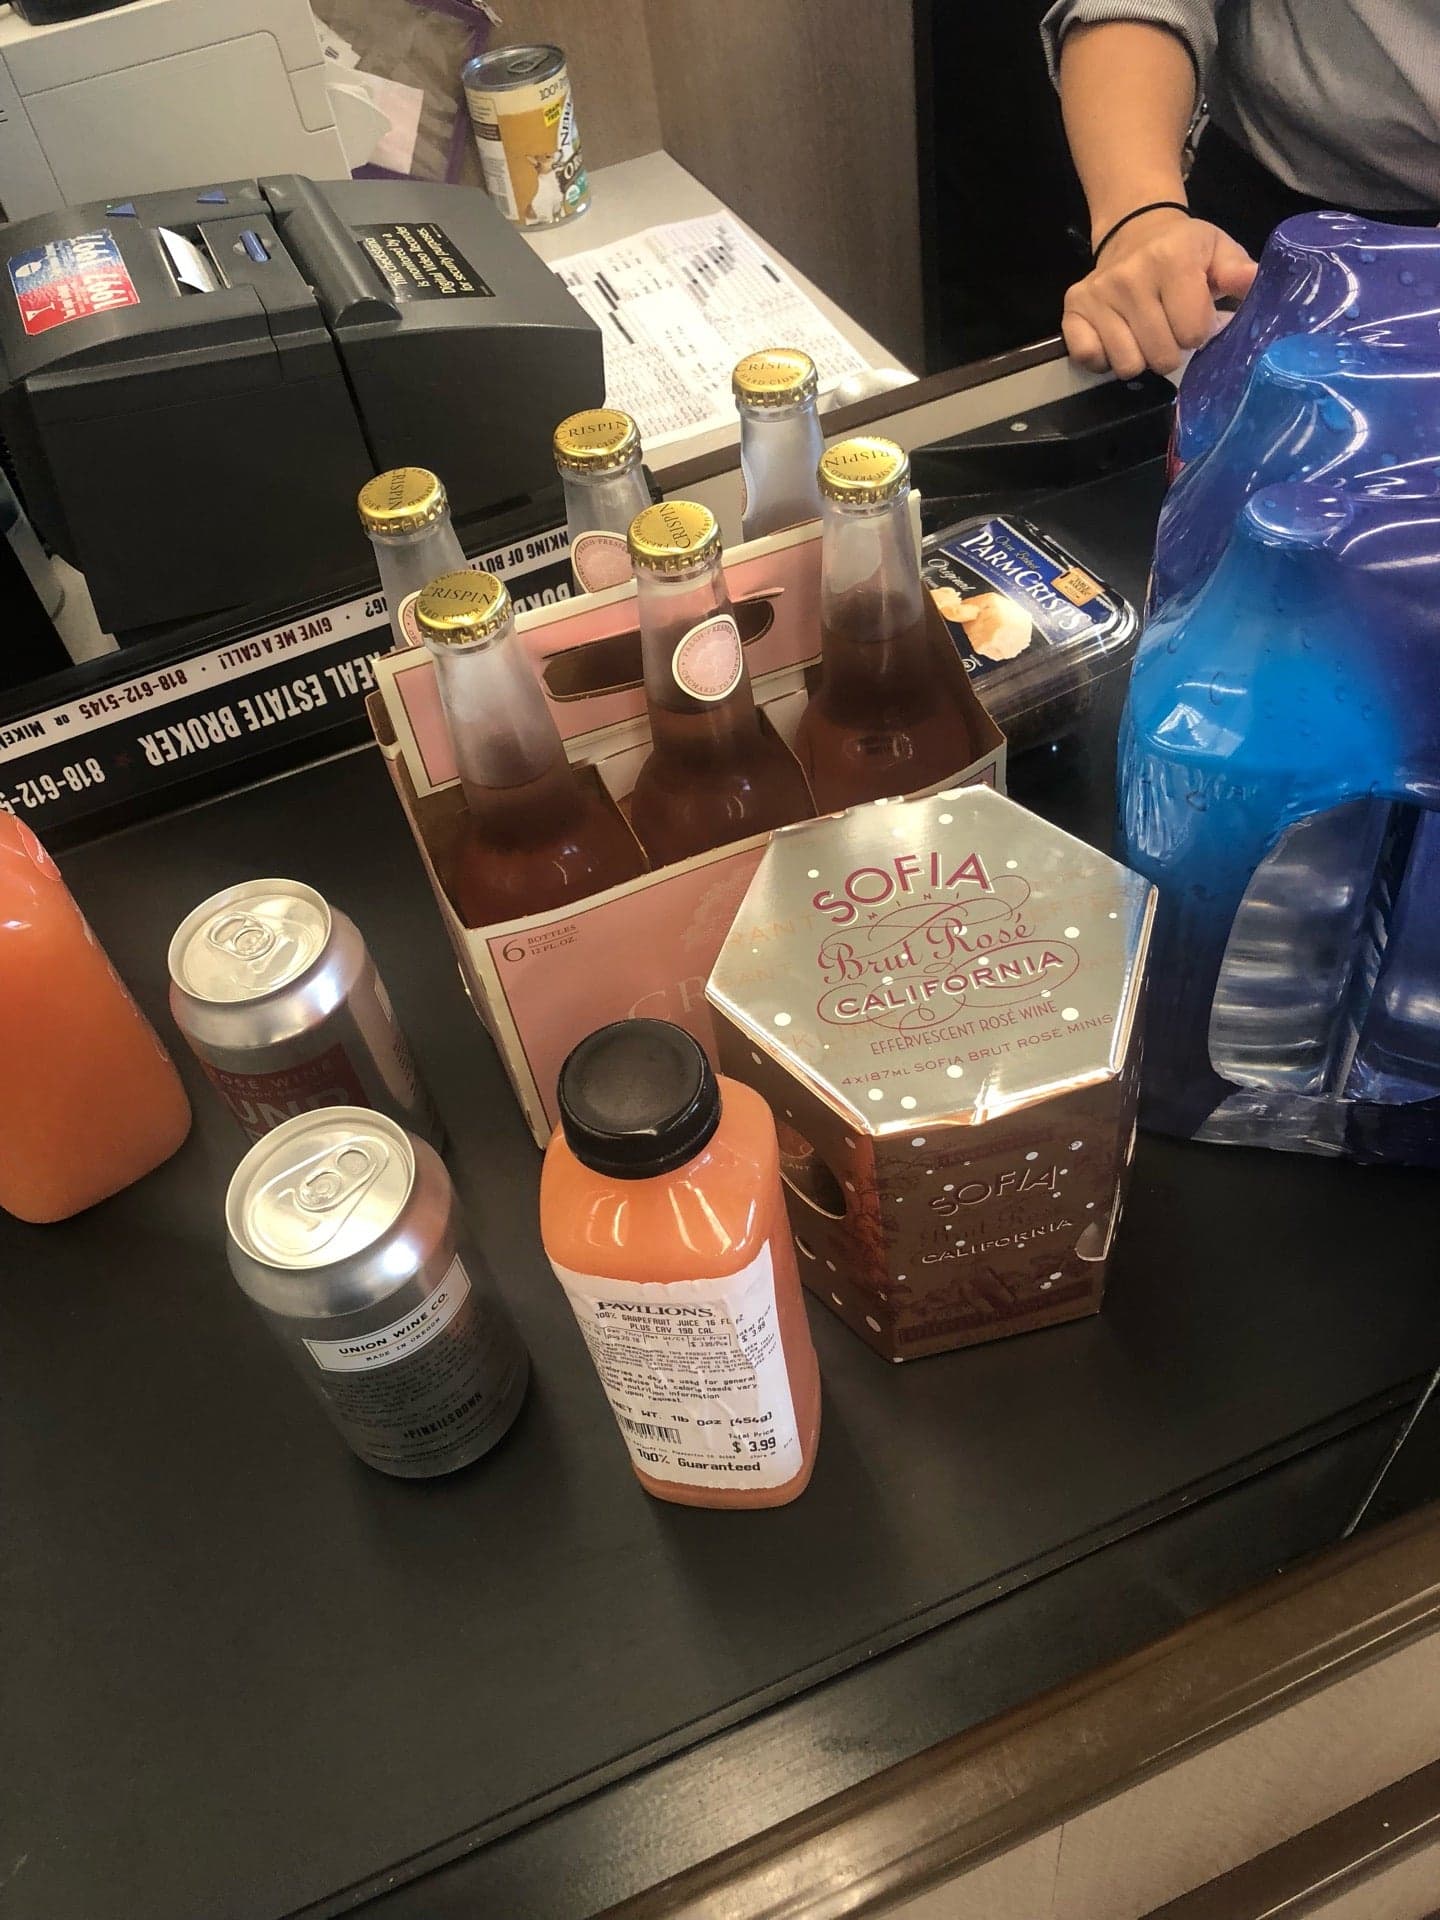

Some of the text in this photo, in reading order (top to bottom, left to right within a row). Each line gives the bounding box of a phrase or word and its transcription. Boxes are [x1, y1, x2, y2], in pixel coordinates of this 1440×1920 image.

[385, 238, 401, 248] by
[395, 225, 457, 295] Digital Video Recorder
[390, 246, 425, 281] monitored
[390, 271, 408, 286] This
[439, 256, 467, 282] security
[82, 272, 130, 311] 1997
[460, 281, 475, 292] for
[555, 420, 630, 441] CRISPIN
[823, 450, 892, 469] RISPIN
[389, 467, 407, 511] CRISPIN
[658, 503, 692, 550] CRISPIN
[508, 547, 524, 567] OF
[927, 558, 977, 592] Original
[422, 586, 494, 606] CRISPIN
[217, 616, 333, 671] GIVE ME A CALL!
[78, 668, 188, 720] 818-612-5145
[237, 674, 328, 732] ESTATE
[137, 705, 242, 766] BROKER
[812, 850, 996, 927] SOFIA
[502, 939, 526, 962] 6
[528, 923, 578, 945] BOTTLES
[816, 940, 921, 985] Brut
[926, 912, 1038, 961] Rosé
[834, 950, 1065, 1019] CALIFORNIA
[870, 1021, 975, 1056] EFFERVESCENT
[978, 1008, 1016, 1033] ROSÉ
[1018, 1000, 1060, 1022] WINE
[913, 1054, 966, 1074] SOFIA
[968, 1042, 1012, 1063] BRUT
[1066, 1013, 1115, 1036] MINIS
[928, 1164, 1058, 1217] SOFIA
[921, 1219, 1073, 1264] CALIFORNIA
[338, 1291, 449, 1356] UNION WINE CO.
[595, 1311, 617, 1321] 100%
[621, 1314, 671, 1326] GRAPEFRUIT
[676, 1319, 700, 1327] JUICE
[706, 1319, 716, 1327] 16
[720, 1317, 732, 1326] FL
[629, 1322, 652, 1332] PLUS
[655, 1325, 672, 1334] CRV
[365, 1350, 391, 1362] MADE
[410, 1316, 442, 1344] OREGON
[668, 1390, 720, 1400] information
[723, 1374, 756, 1386] general
[728, 1427, 775, 1440] Total Price
[730, 1411, 773, 1427] (454g)
[636, 1447, 671, 1465] 100%
[677, 1457, 761, 1471] Guaranteed
[732, 1436, 777, 1453] $ 3.99
